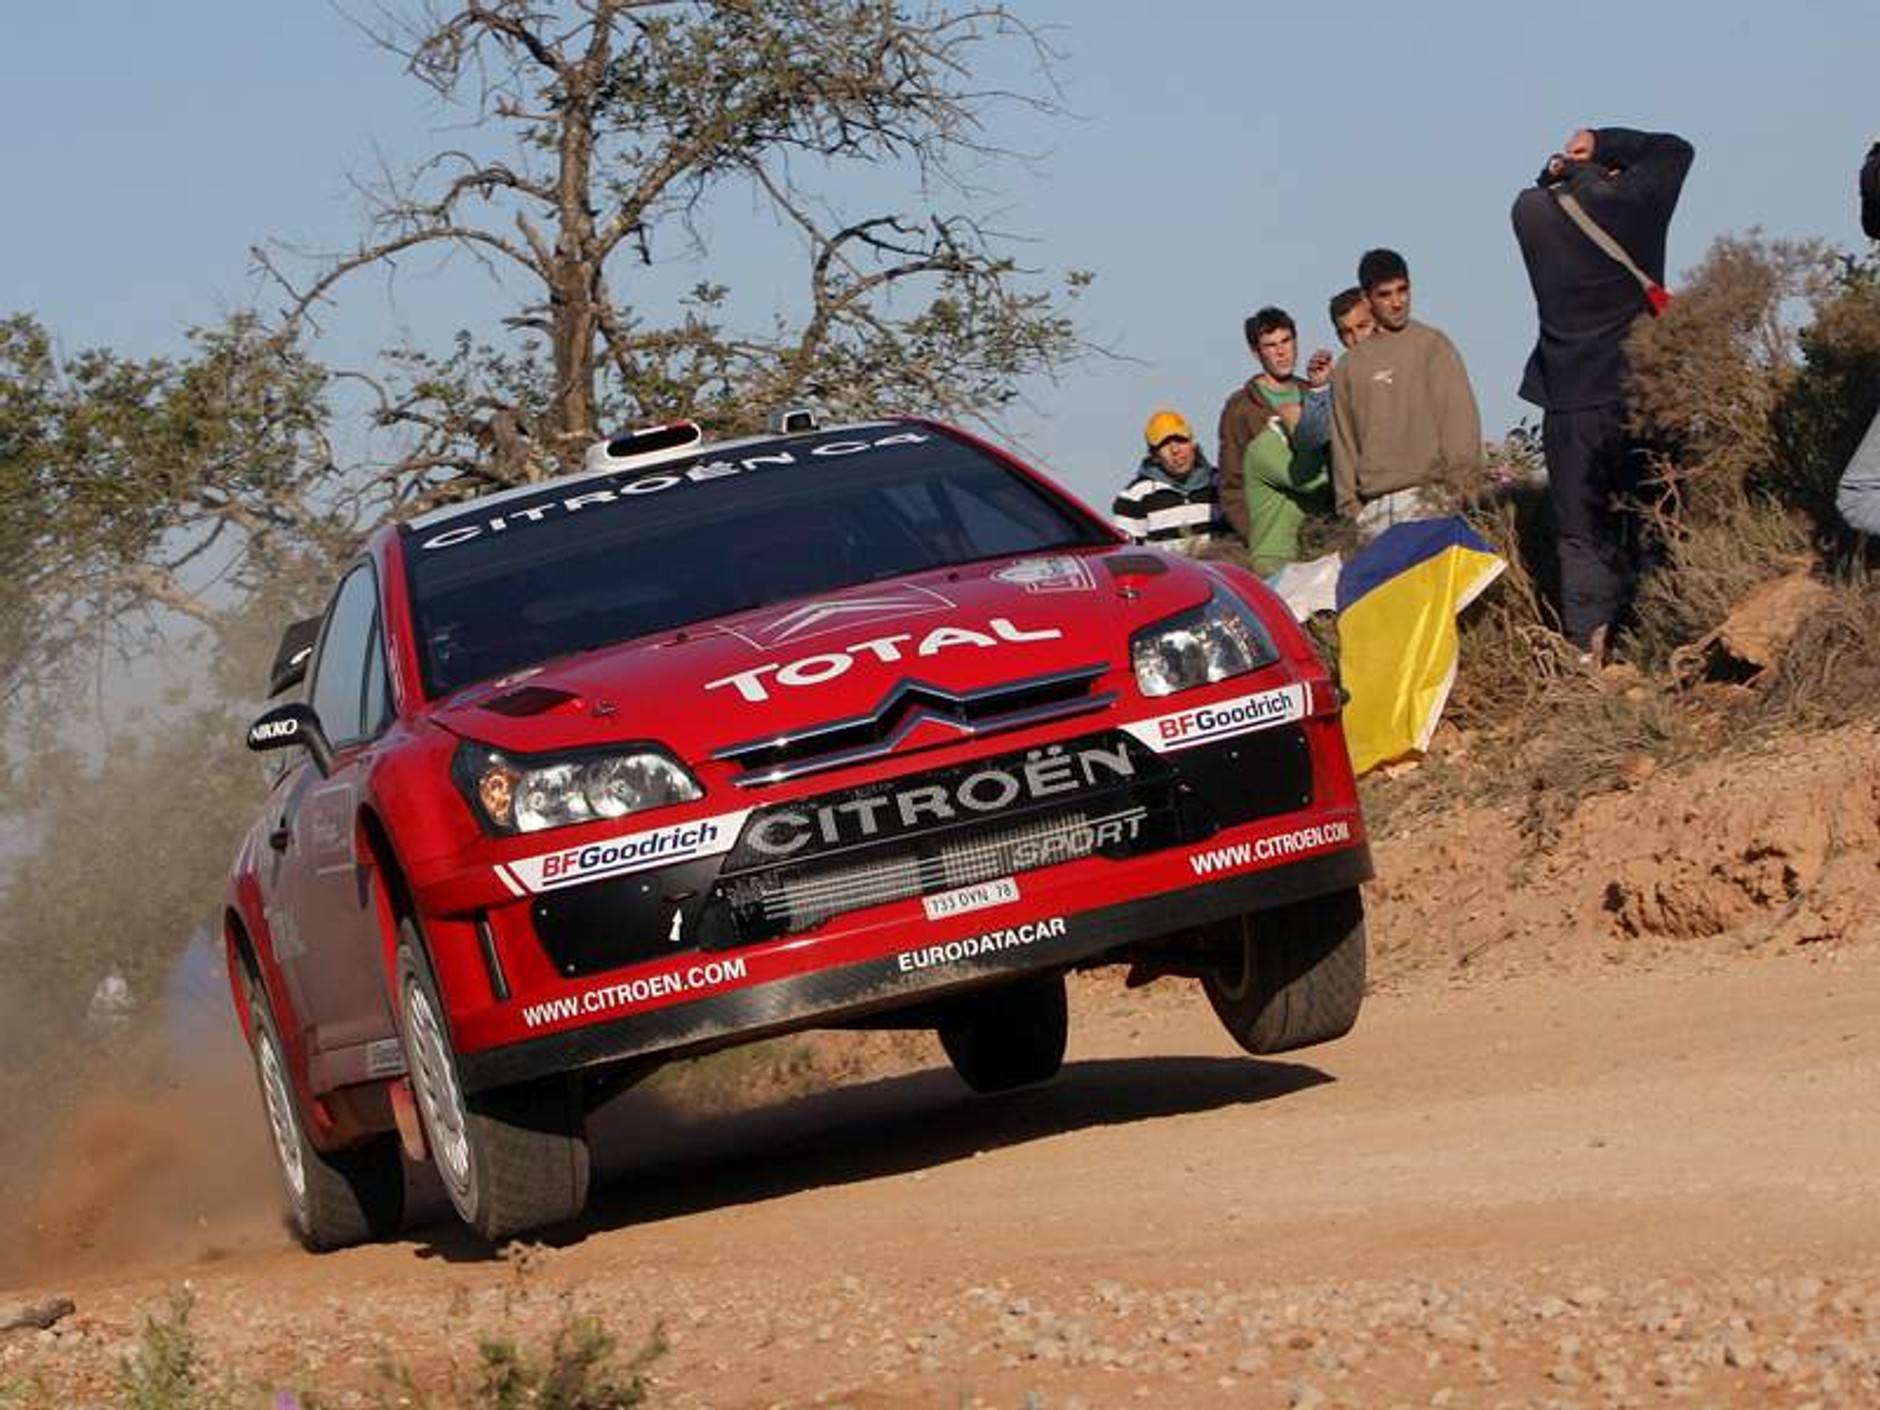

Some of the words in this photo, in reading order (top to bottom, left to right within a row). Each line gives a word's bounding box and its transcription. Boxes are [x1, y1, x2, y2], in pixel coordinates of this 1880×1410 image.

[421, 450, 797, 549] CITROËN
[812, 432, 928, 455] C4
[705, 617, 1062, 702] TOTAL
[1158, 692, 1293, 740] BFGoodrich
[746, 743, 1136, 855] CITROËN
[541, 822, 718, 879] BFGoodrich
[1013, 813, 1148, 870] SPORT
[1190, 824, 1351, 876] WWW.CITROEN.COM
[897, 917, 1067, 972] EURODATACAR
[522, 958, 747, 1027] WWW.CITROEN.COM
